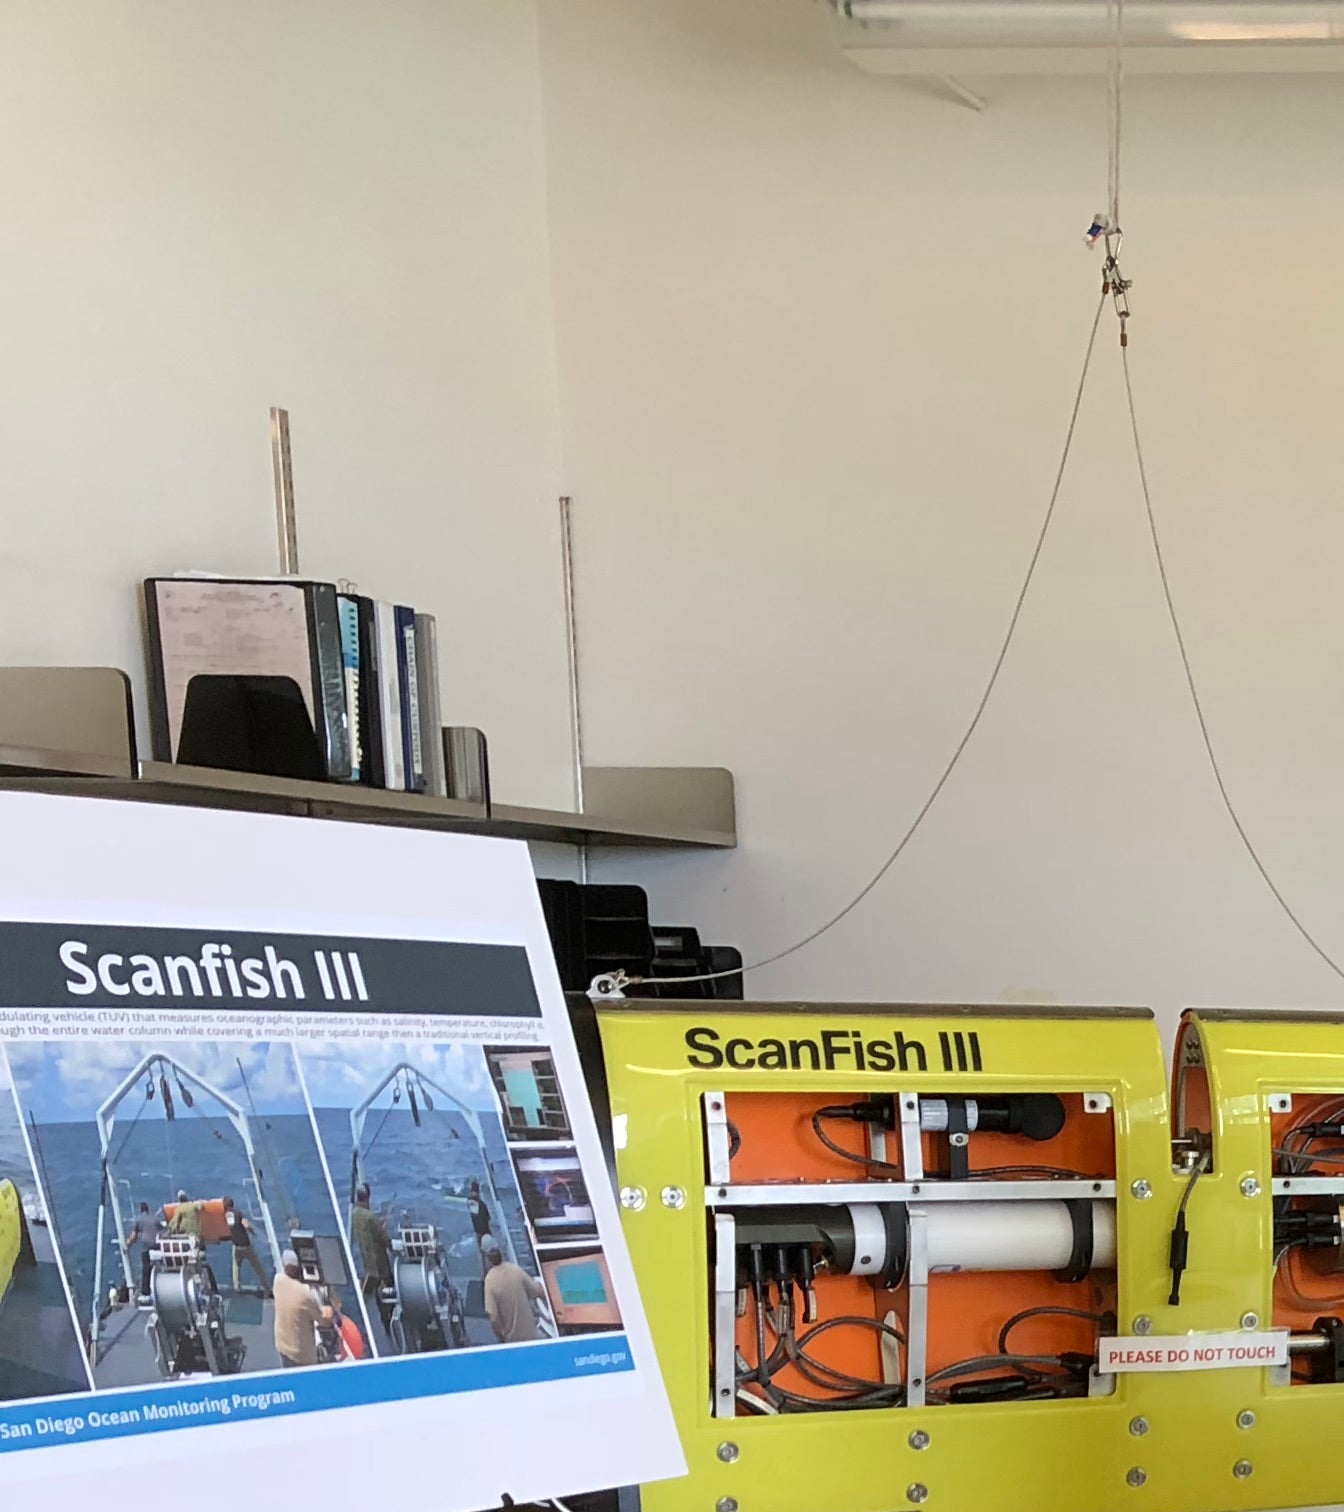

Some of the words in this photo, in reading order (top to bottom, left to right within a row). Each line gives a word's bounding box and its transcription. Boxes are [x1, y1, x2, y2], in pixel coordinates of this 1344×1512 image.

[59, 940, 304, 999] Scanfish
[314, 950, 369, 1000] III
[29, 1025, 49, 1035] the
[52, 1025, 88, 1035] entire
[91, 1026, 124, 1035] water
[129, 1025, 170, 1036] column
[175, 1025, 204, 1036] while
[207, 1026, 253, 1039] covering
[255, 1028, 261, 1036] a
[264, 1026, 293, 1036] much
[295, 1028, 324, 1039] larger
[328, 1028, 359, 1039] spatial
[51, 1011, 94, 1022] vehicle
[98, 1011, 130, 1023] (TUV)
[132, 1012, 155, 1022] that
[159, 1013, 214, 1023] measures
[217, 1012, 293, 1026] oceanographic
[297, 1014, 354, 1026] parameters
[356, 1016, 379, 1026] such
[685, 1027, 927, 1071] ScanFish
[938, 1031, 982, 1071] III
[1110, 1350, 1162, 1364] PLEASE
[1168, 1350, 1189, 1362] DO
[1194, 1348, 1223, 1361] NOT
[1227, 1346, 1275, 1360] TOUCH
[1, 1422, 32, 1439] San
[36, 1416, 85, 1434] Diego
[88, 1409, 140, 1427] Ocean
[143, 1396, 230, 1421] Monitoring
[233, 1390, 295, 1411] Program
